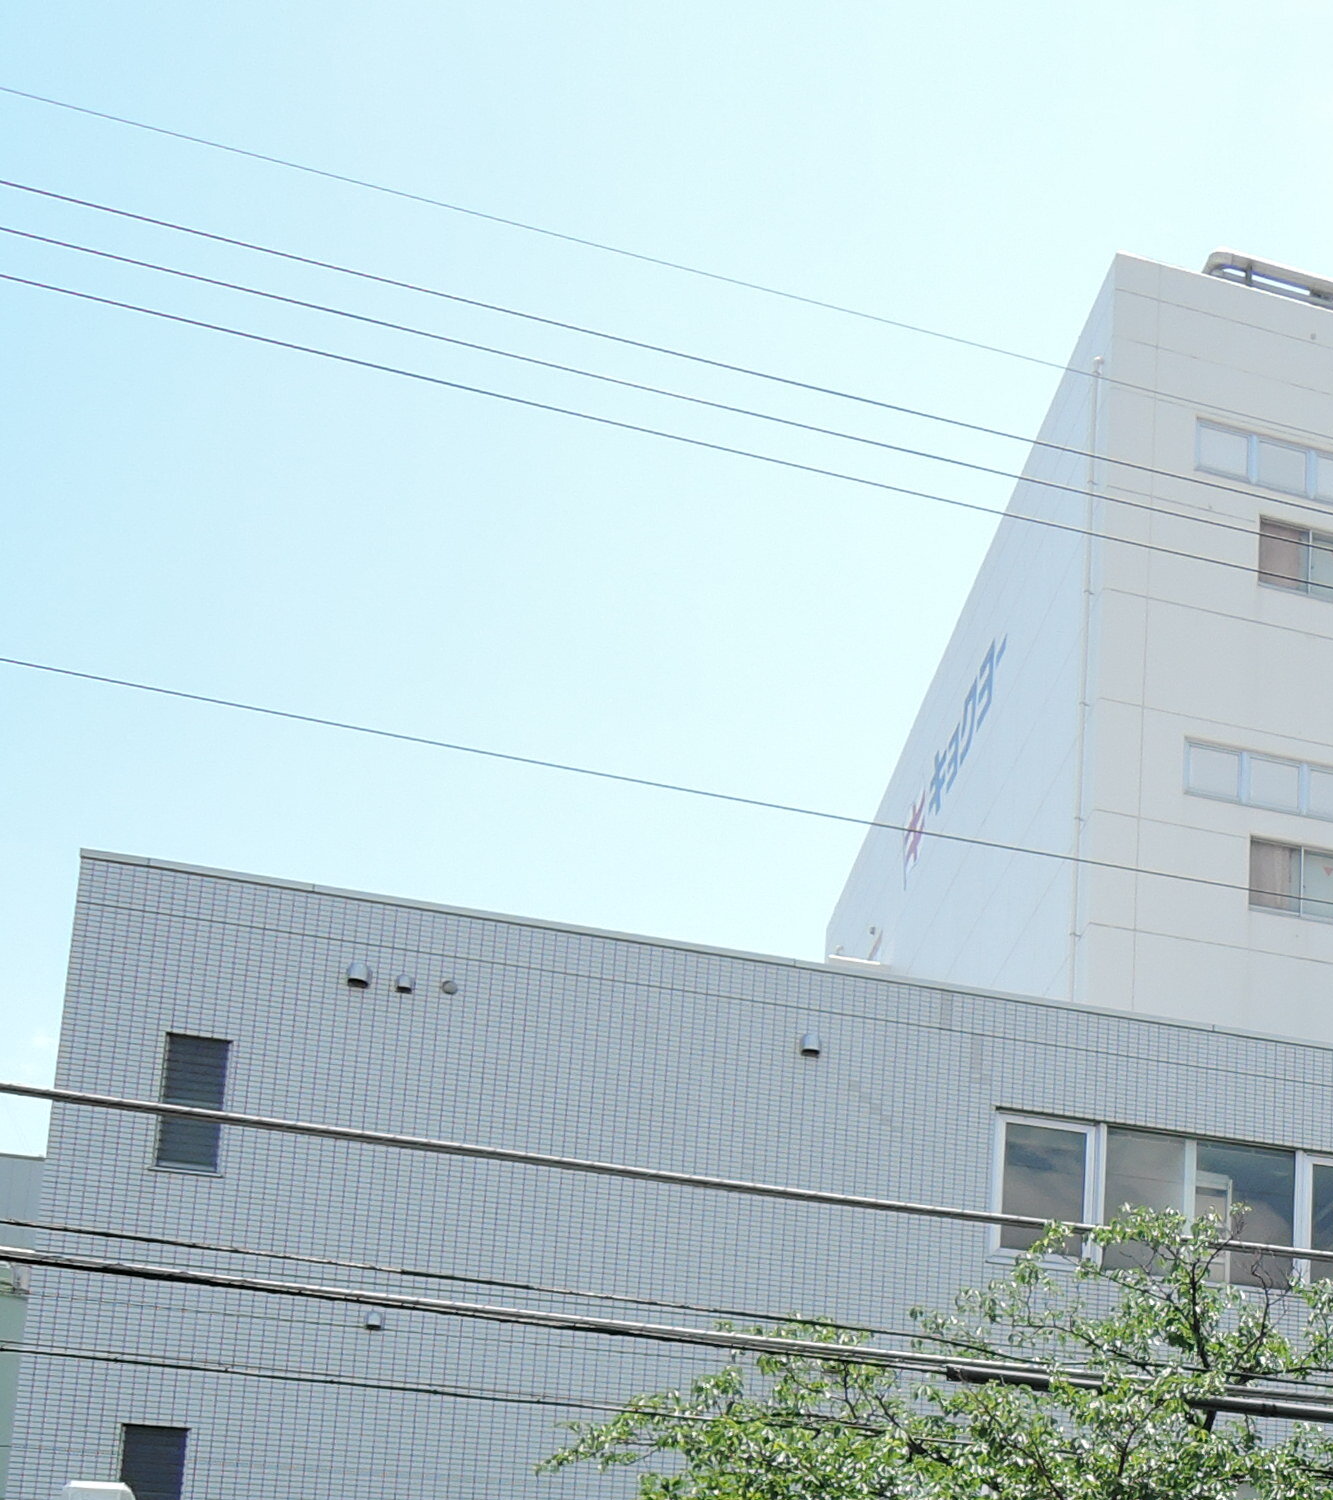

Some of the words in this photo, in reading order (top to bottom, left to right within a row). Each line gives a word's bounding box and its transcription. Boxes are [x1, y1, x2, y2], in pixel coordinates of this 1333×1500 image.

[928, 633, 1008, 816] キョクヨー
